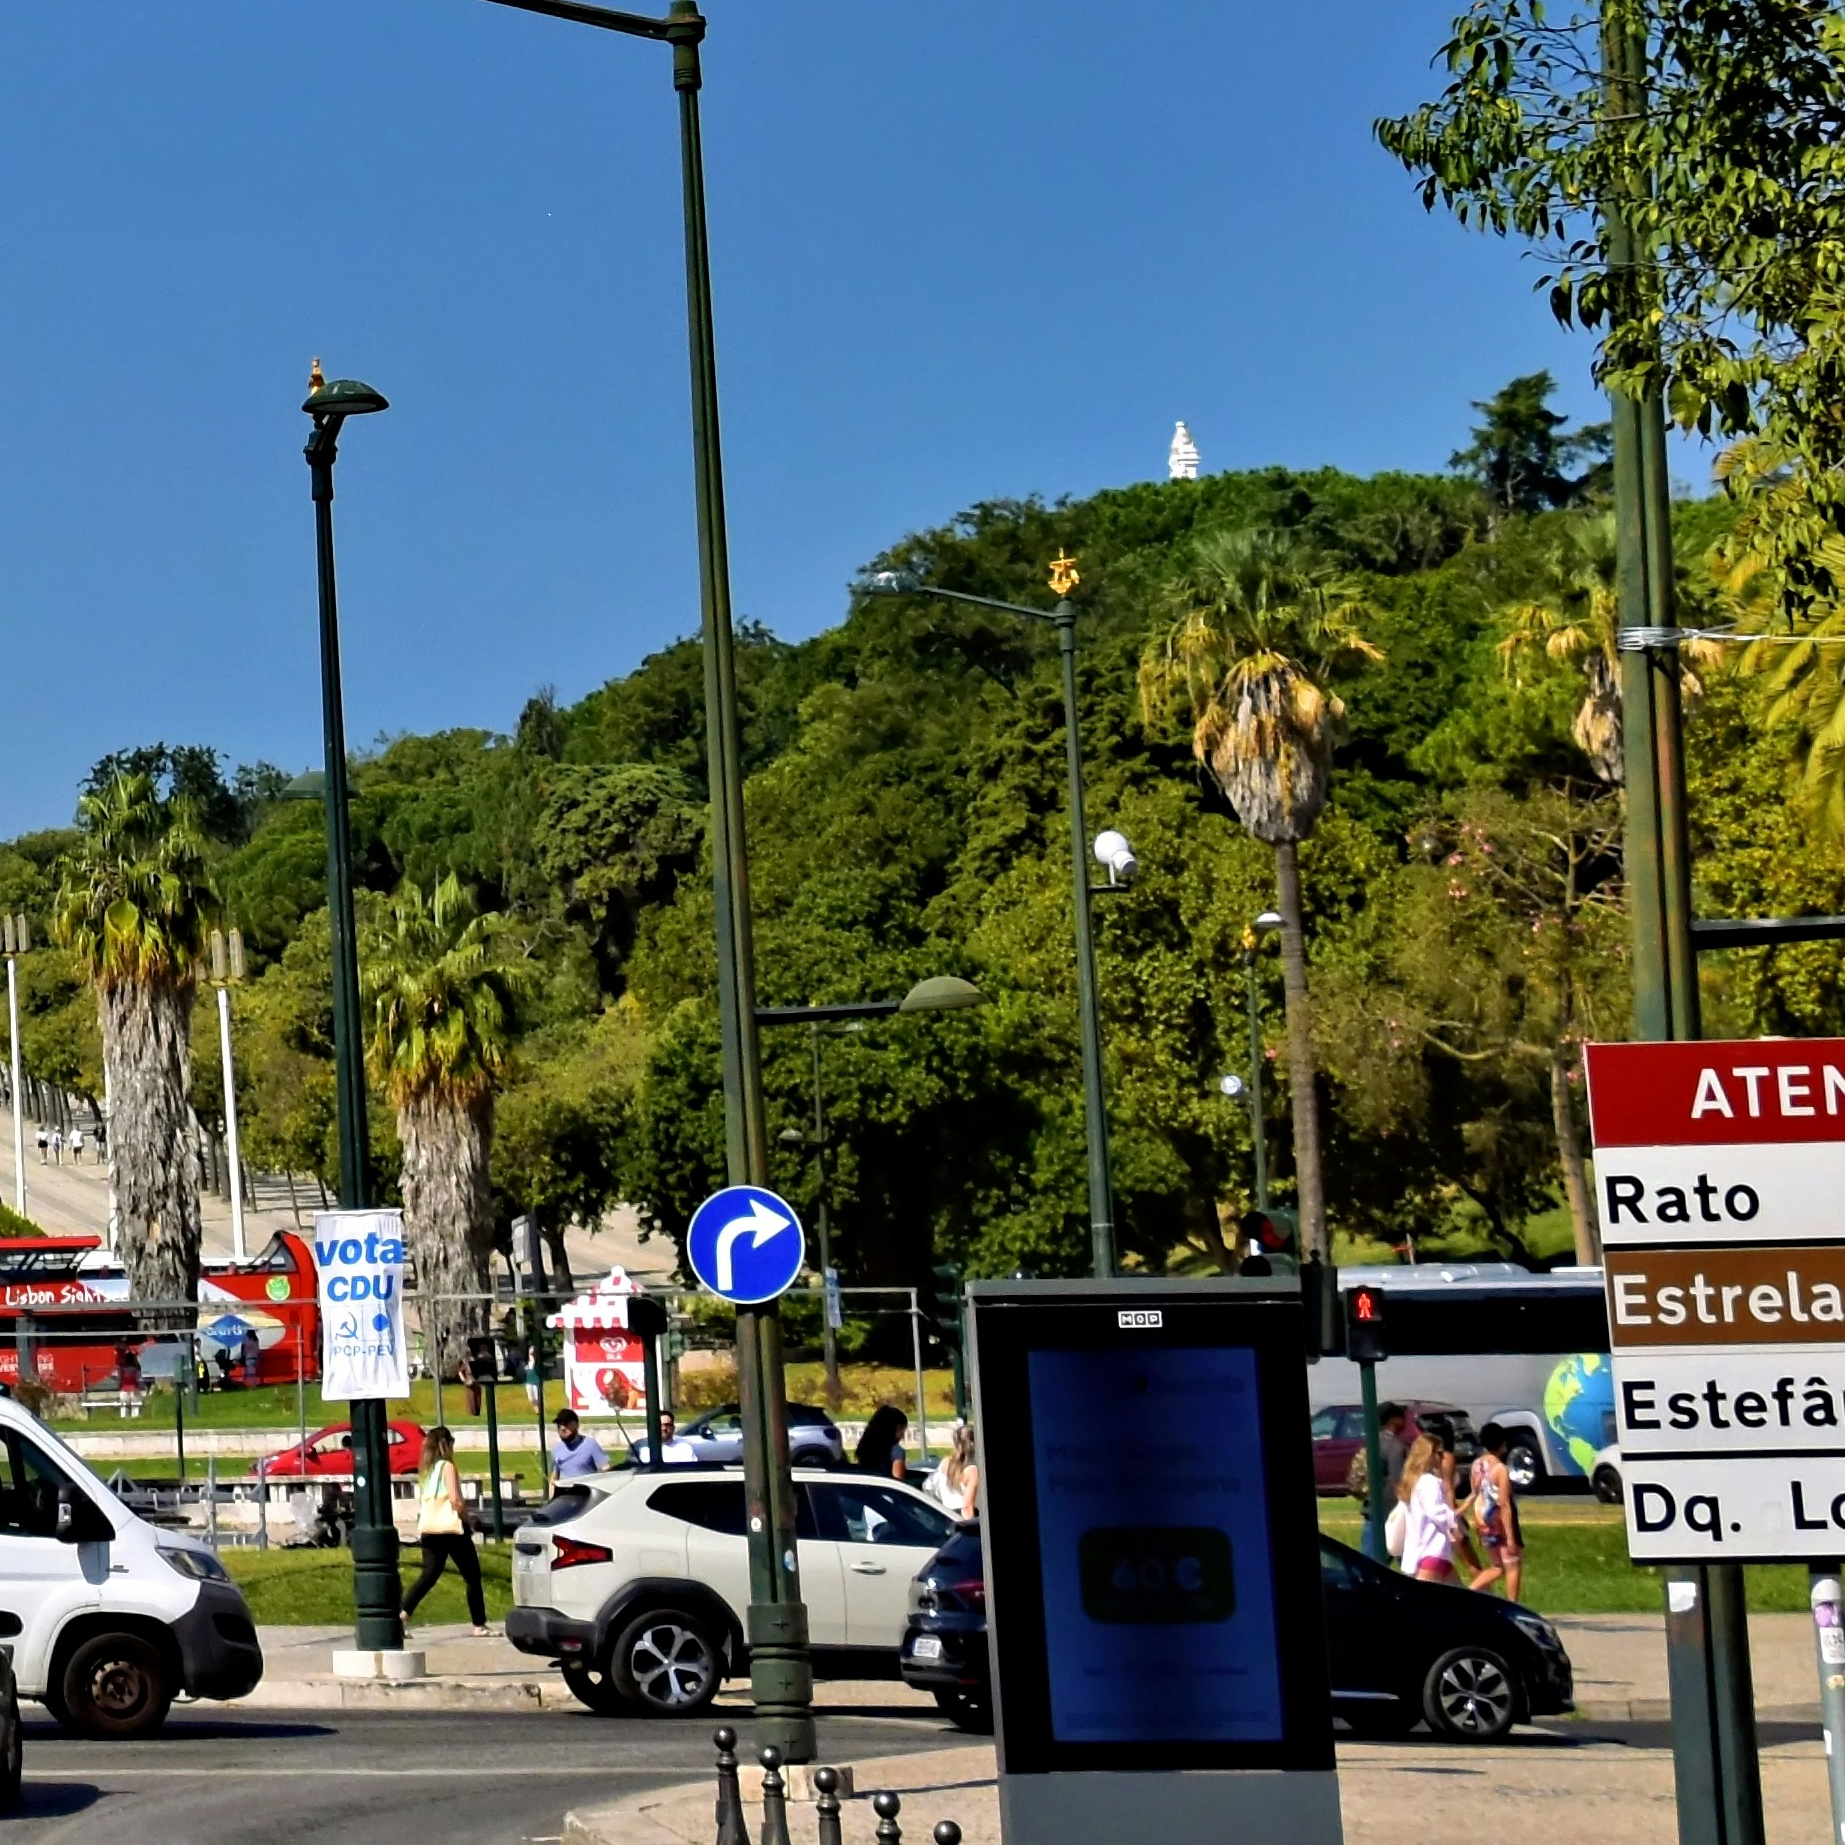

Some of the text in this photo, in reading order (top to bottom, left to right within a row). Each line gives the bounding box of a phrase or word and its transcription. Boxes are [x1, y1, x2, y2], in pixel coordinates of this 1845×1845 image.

[1605, 1173, 1760, 1224] Rato
[315, 1231, 404, 1268] vota
[5, 1284, 55, 1306] Lisbon
[327, 1274, 394, 1303] CDU
[1612, 1270, 1845, 1325] Estrela
[1622, 1376, 1845, 1430] Estefâ
[1632, 1483, 1742, 1542] Dq.
